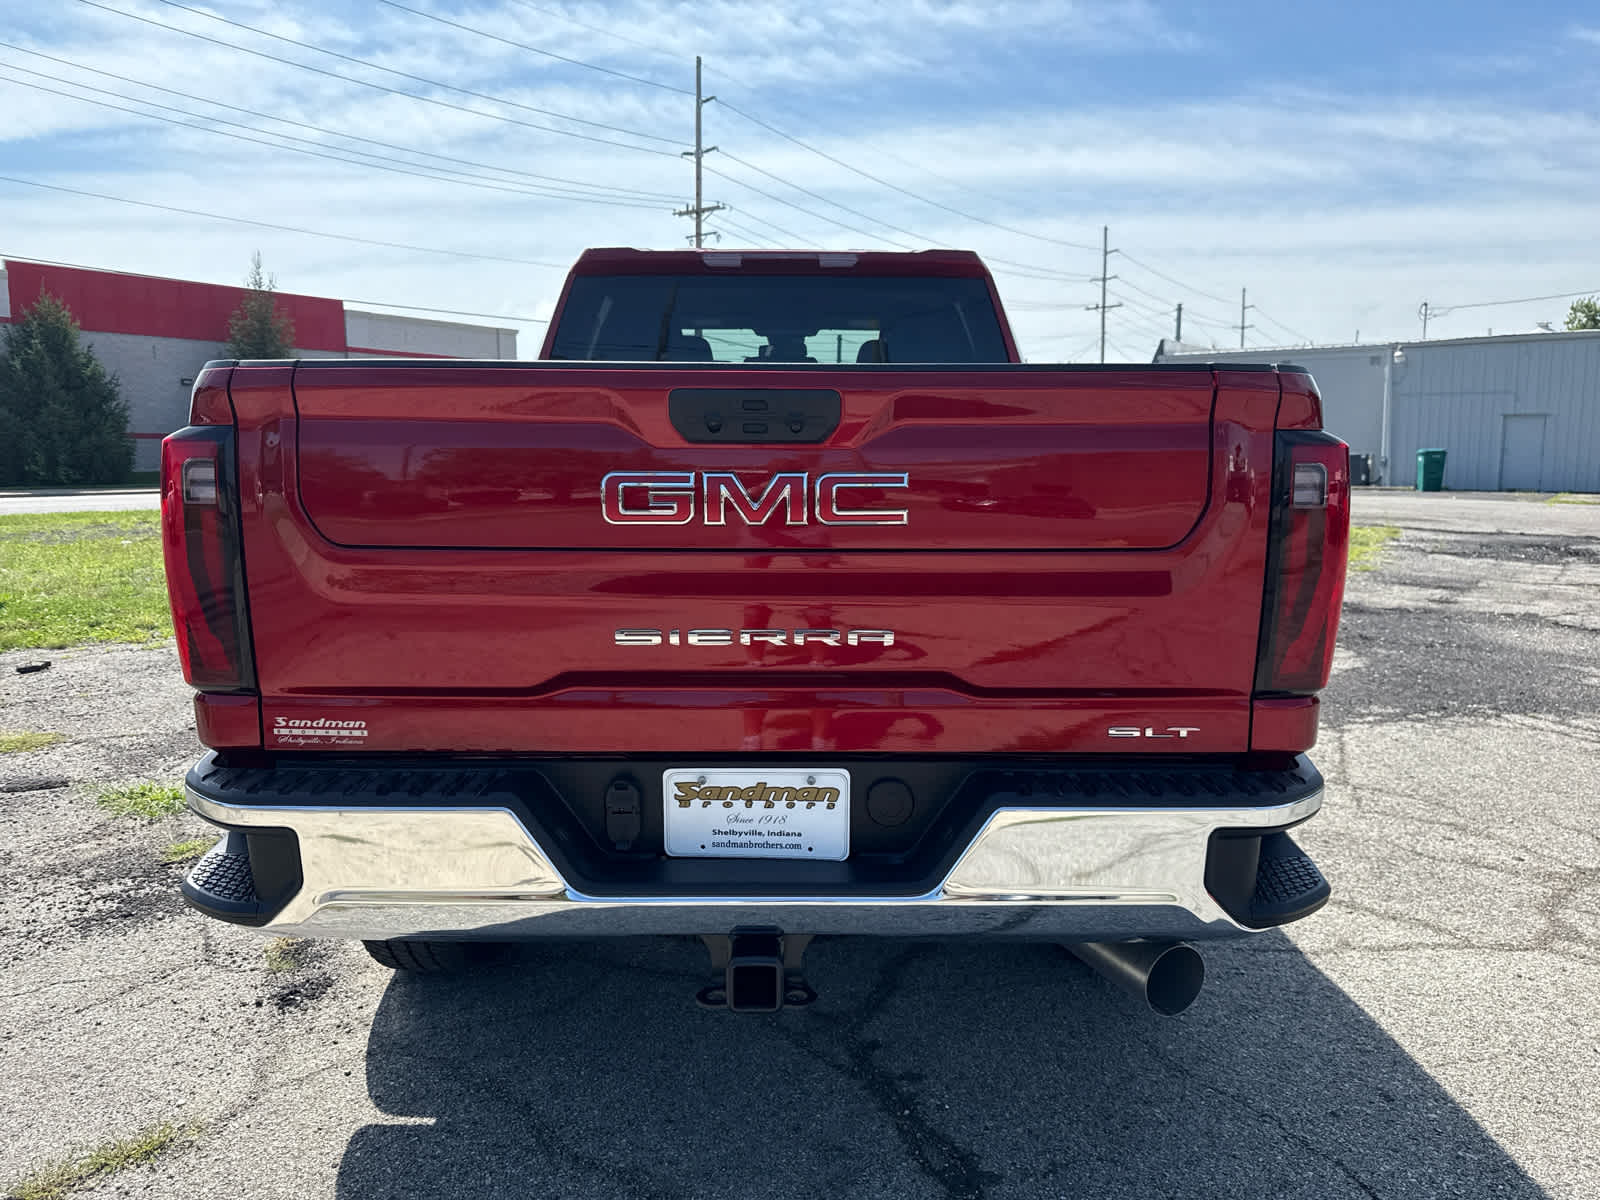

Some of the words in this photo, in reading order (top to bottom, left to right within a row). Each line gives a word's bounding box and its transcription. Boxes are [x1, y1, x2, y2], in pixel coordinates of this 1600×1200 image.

[600, 471, 909, 526] GMC
[614, 628, 895, 646] SIERRA
[274, 716, 367, 728] Sandman
[1107, 726, 1201, 738] SLT
[673, 781, 841, 802] Sandman
[726, 812, 754, 826] Since
[757, 814, 788, 825] 1918
[711, 828, 765, 839] Shelbyville,
[767, 829, 803, 838] Indiana
[711, 839, 802, 851] sandmanbrothers.com
